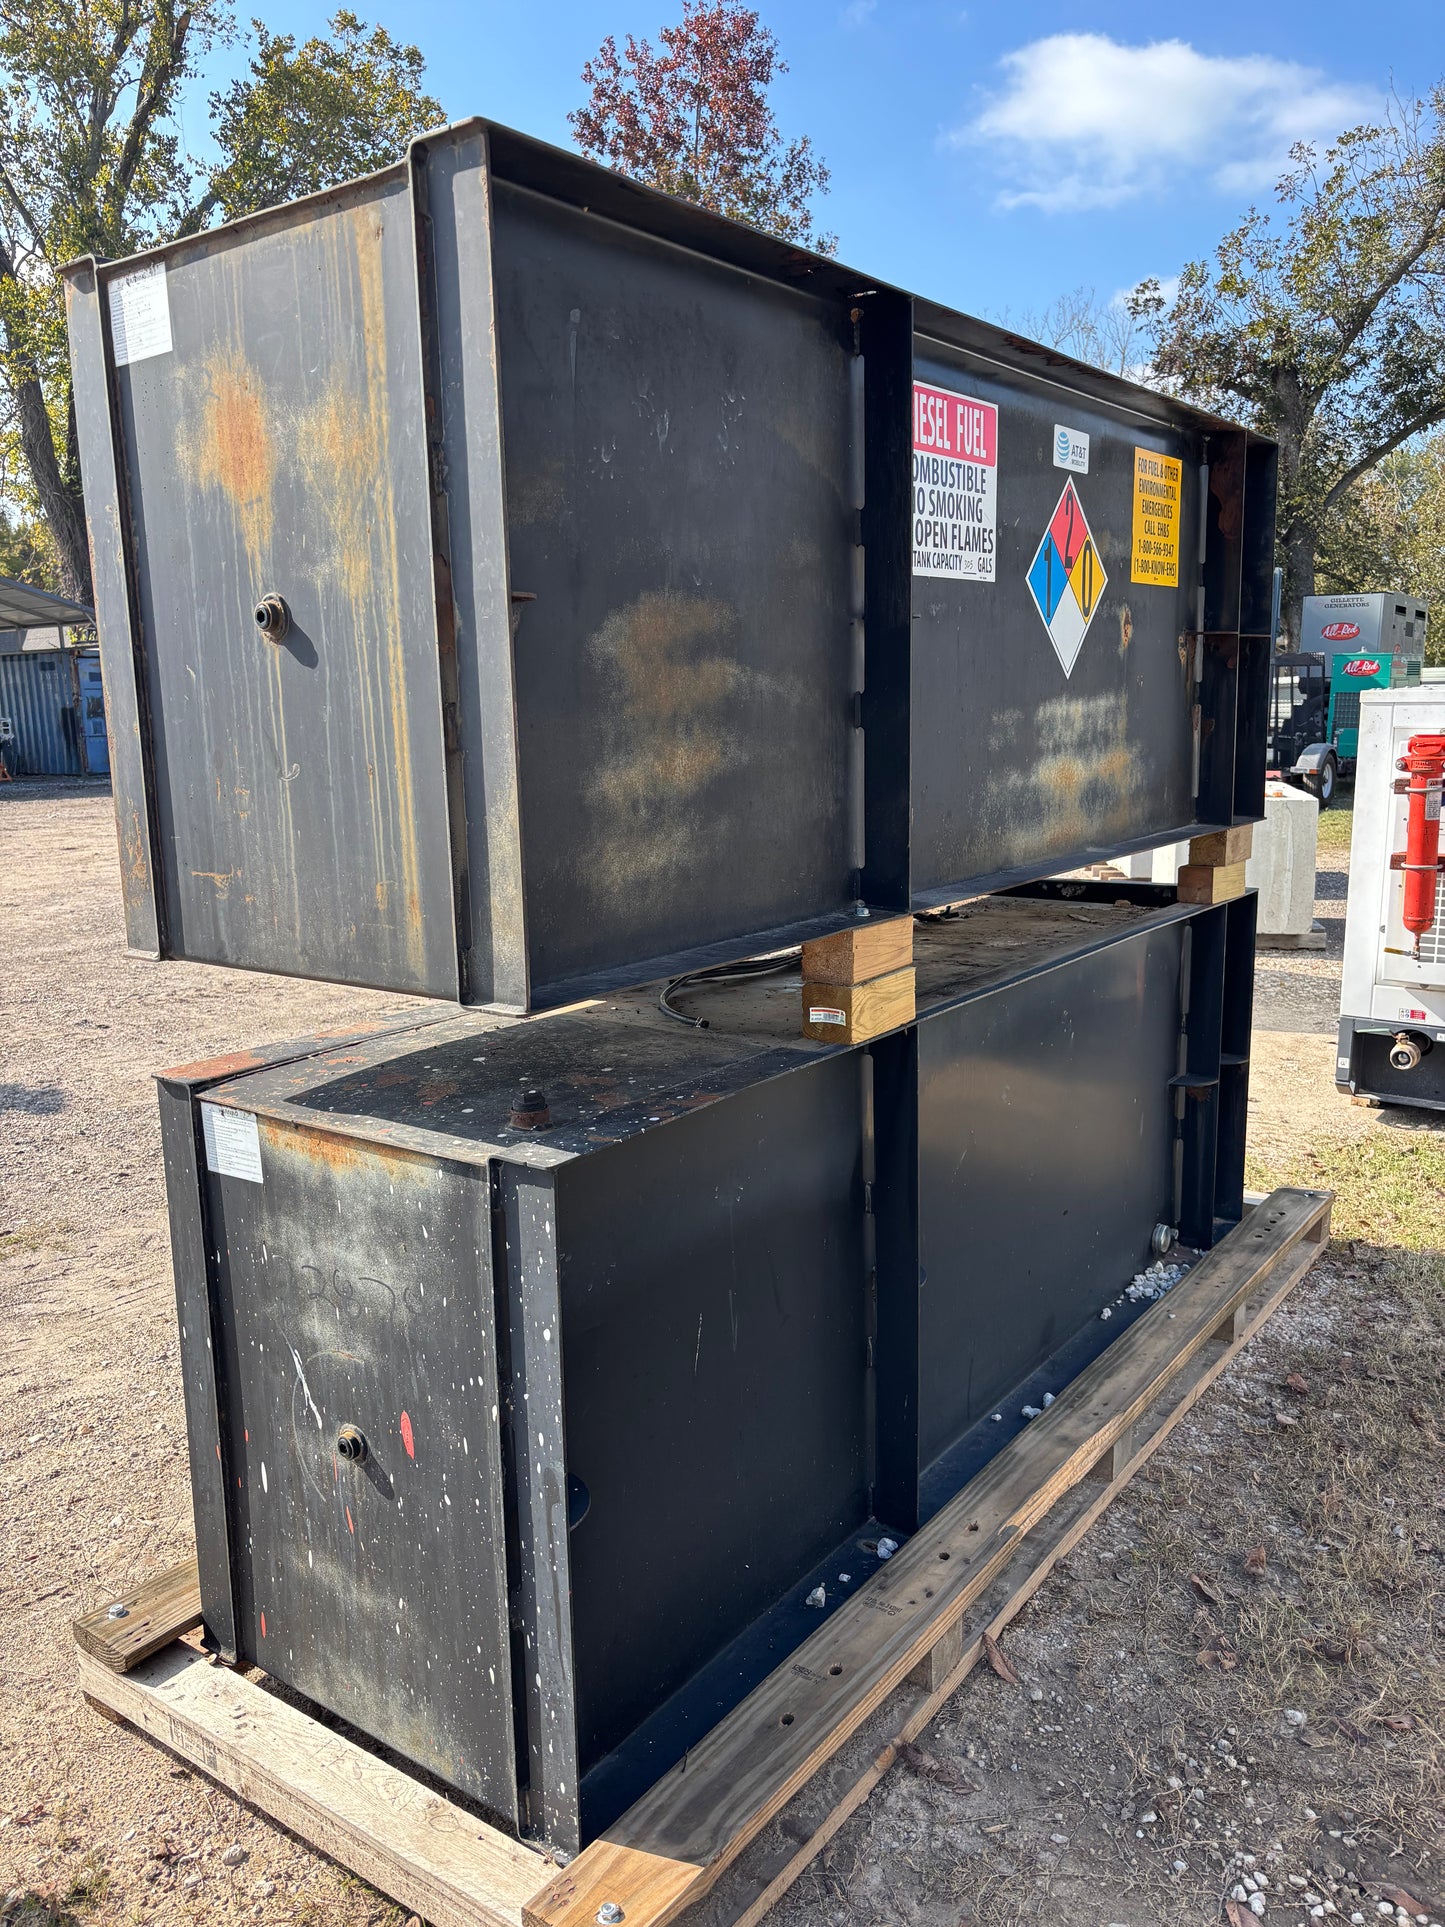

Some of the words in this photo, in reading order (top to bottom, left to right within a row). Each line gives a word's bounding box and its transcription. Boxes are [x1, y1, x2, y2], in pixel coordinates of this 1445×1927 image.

[913, 391, 950, 450] IESEL
[956, 403, 987, 459] FUEL
[1071, 444, 1087, 460] AT&T
[1138, 457, 1148, 475] FOR
[1148, 460, 1159, 477] FUEL
[1160, 463, 1164, 478] &
[1164, 465, 1178, 482] OTHER
[1139, 478, 1177, 501] ENVIRONMENTAL
[928, 488, 983, 523] SMOKING
[1142, 499, 1173, 519] EMERGENCIES
[915, 518, 948, 549] OPEN
[951, 523, 994, 554] FLAMES
[1065, 489, 1074, 568] 2
[1144, 520, 1156, 535] CALL
[912, 550, 932, 569] TANK
[932, 552, 963, 571] CAPACITY
[977, 556, 993, 574] GALS
[1044, 537, 1052, 618] 1
[1082, 539, 1093, 617] 0
[1320, 622, 1359, 639] All-Red
[1341, 659, 1379, 675] All-Red
